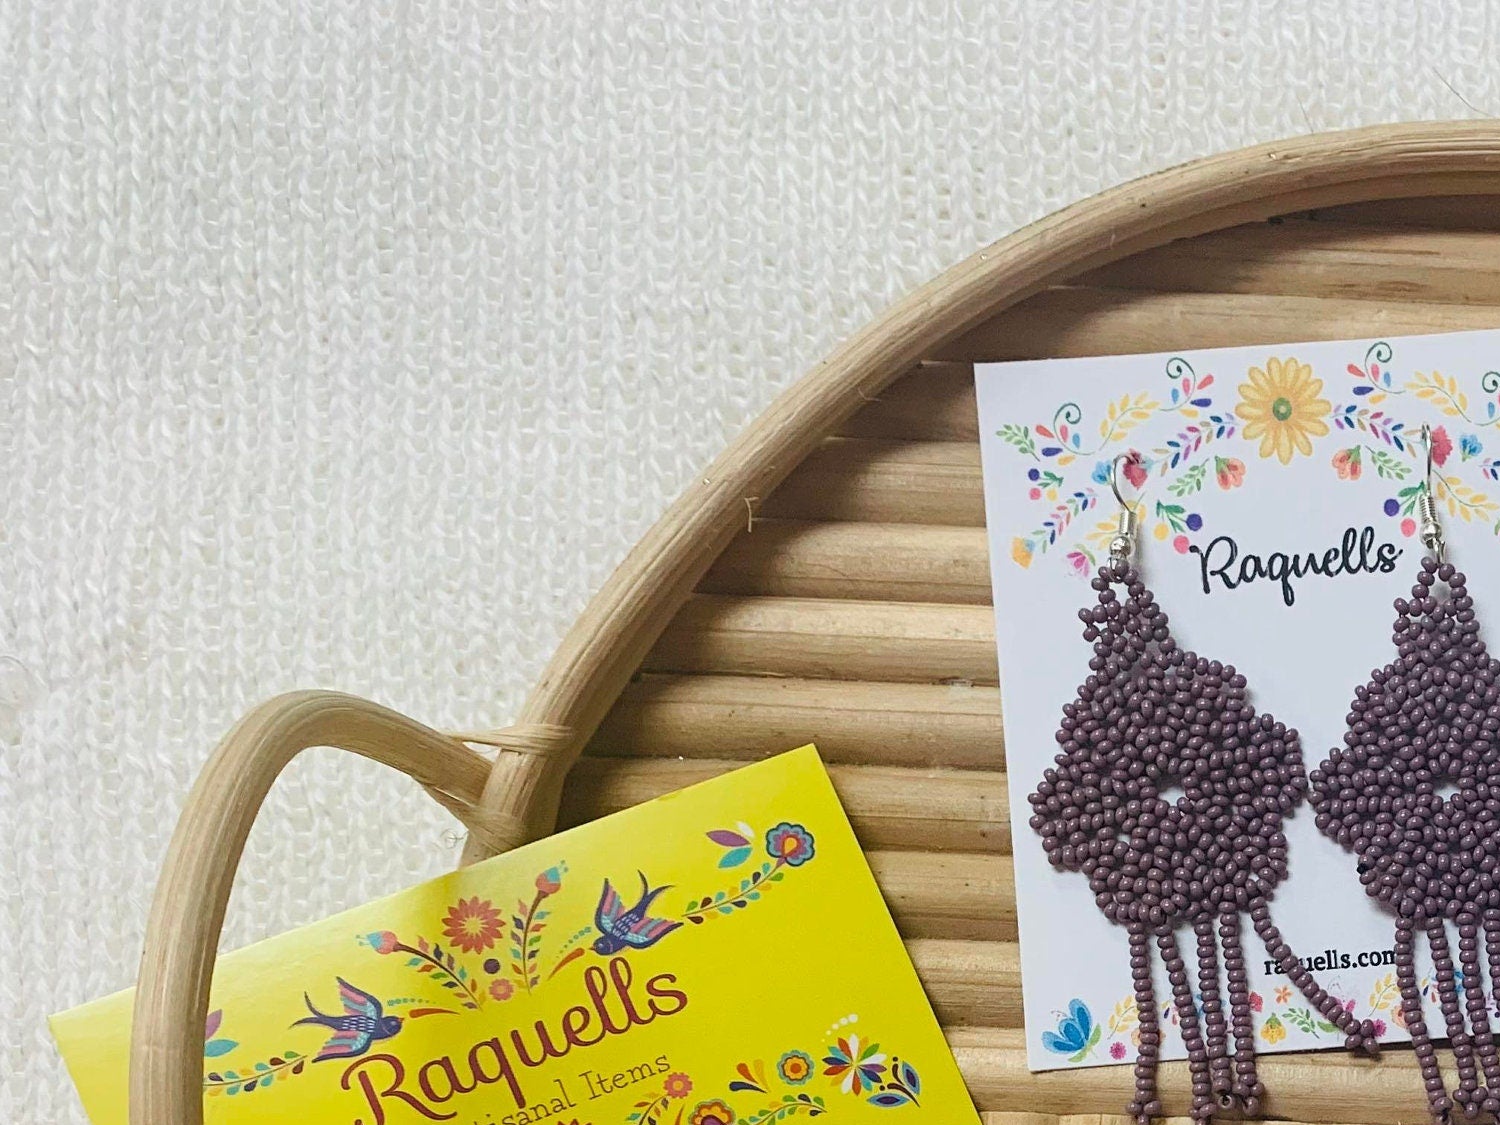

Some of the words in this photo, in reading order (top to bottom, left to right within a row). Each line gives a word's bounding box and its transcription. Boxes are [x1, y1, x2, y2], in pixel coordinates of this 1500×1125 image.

[1189, 526, 1403, 606] Raquells
[1264, 949, 1396, 976] rauells.com
[579, 1054, 671, 1100] Items
